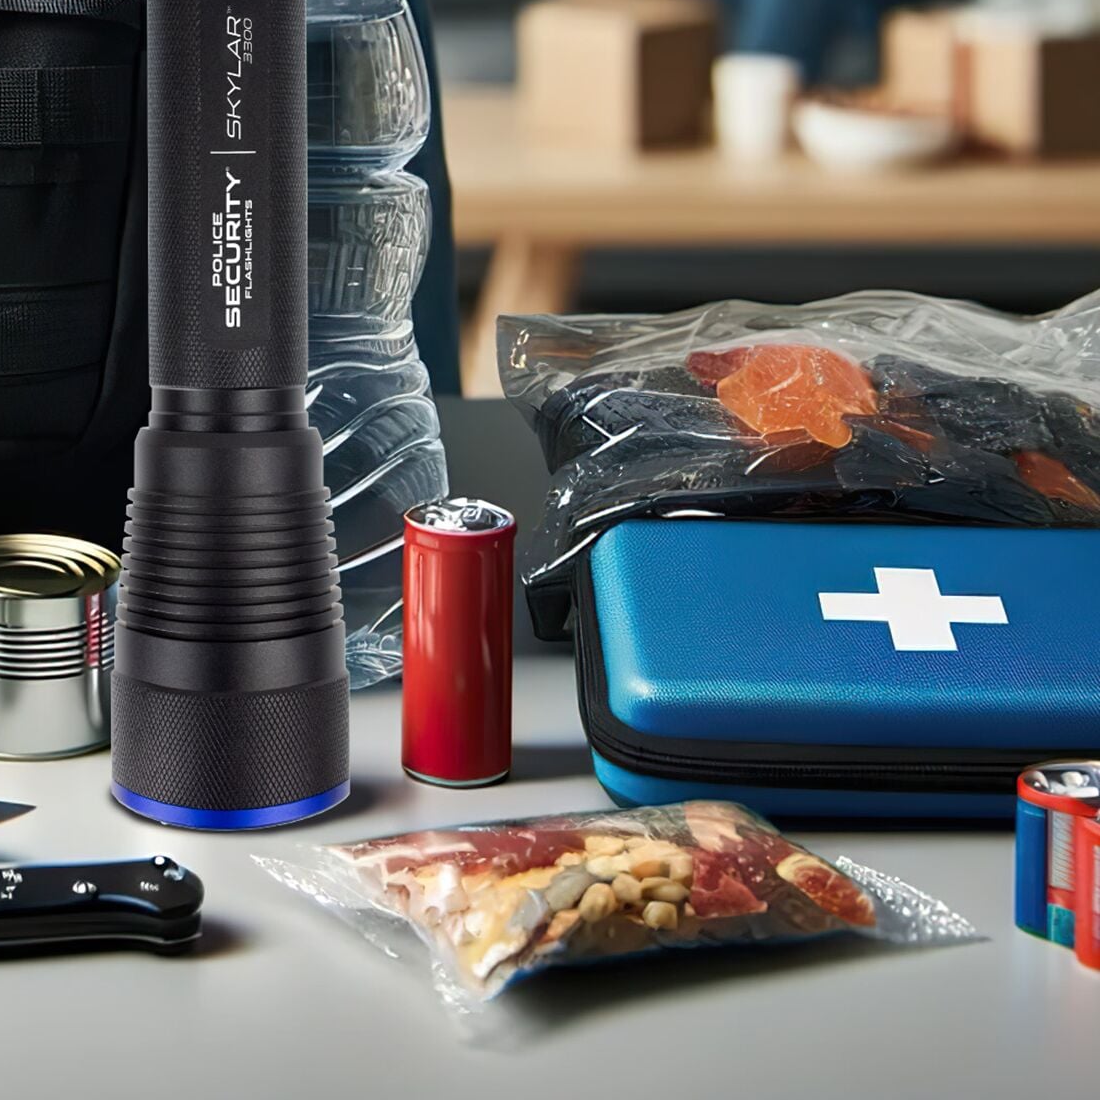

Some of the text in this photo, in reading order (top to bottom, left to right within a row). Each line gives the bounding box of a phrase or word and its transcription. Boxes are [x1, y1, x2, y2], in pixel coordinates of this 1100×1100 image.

[226, 16, 242, 140] SKYLAR
[243, 17, 253, 64] 3300
[212, 212, 223, 287] POLICE
[225, 171, 241, 328] SECURITY
[244, 199, 253, 299] FLASHLIGHTS
